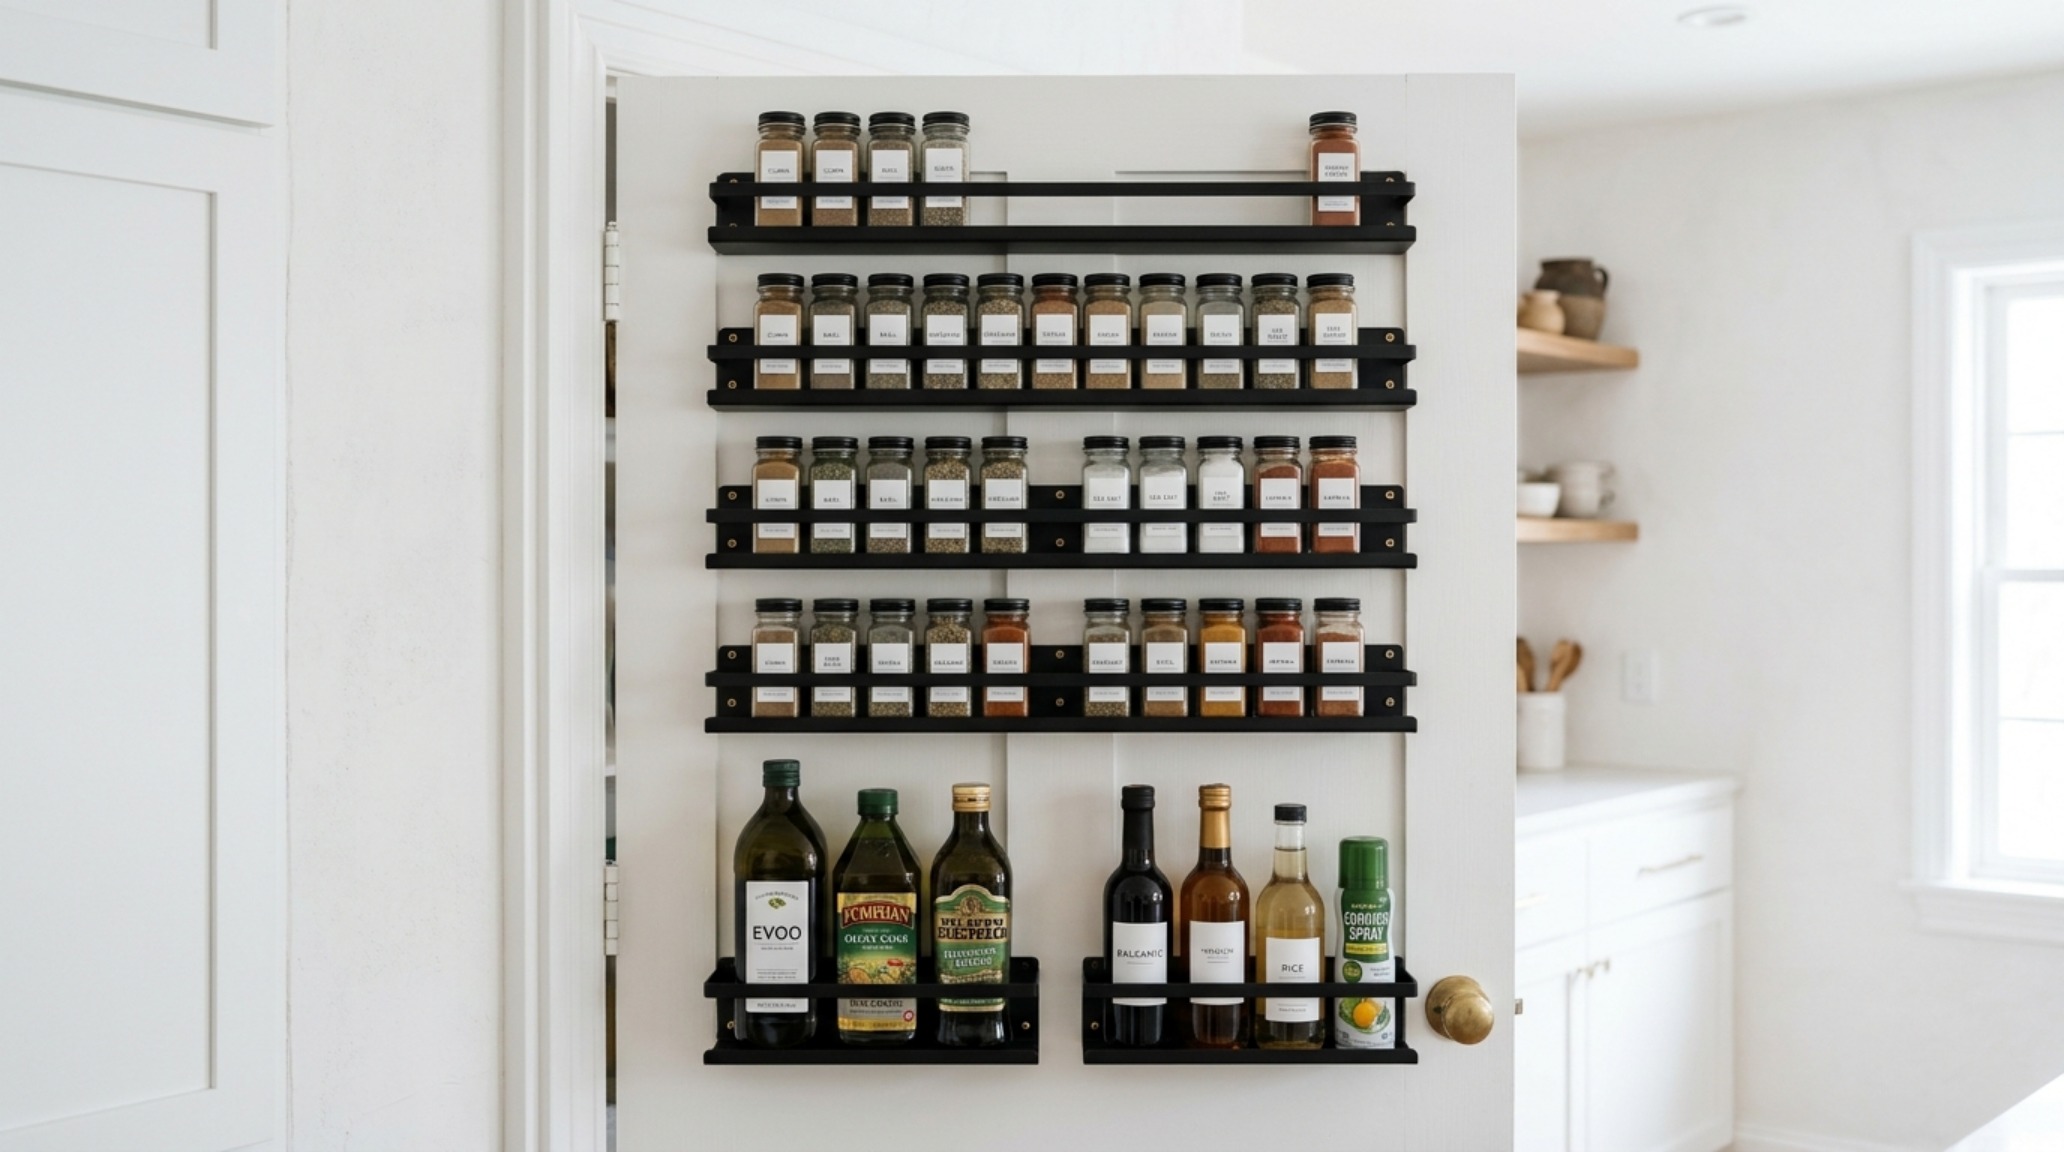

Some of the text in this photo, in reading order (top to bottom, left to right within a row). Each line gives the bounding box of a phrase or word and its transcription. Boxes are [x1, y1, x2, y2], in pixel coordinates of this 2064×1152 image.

[752, 926, 802, 941] EVOO
[1349, 927, 1384, 941] SPRAY
[1281, 964, 1304, 973] RICE
